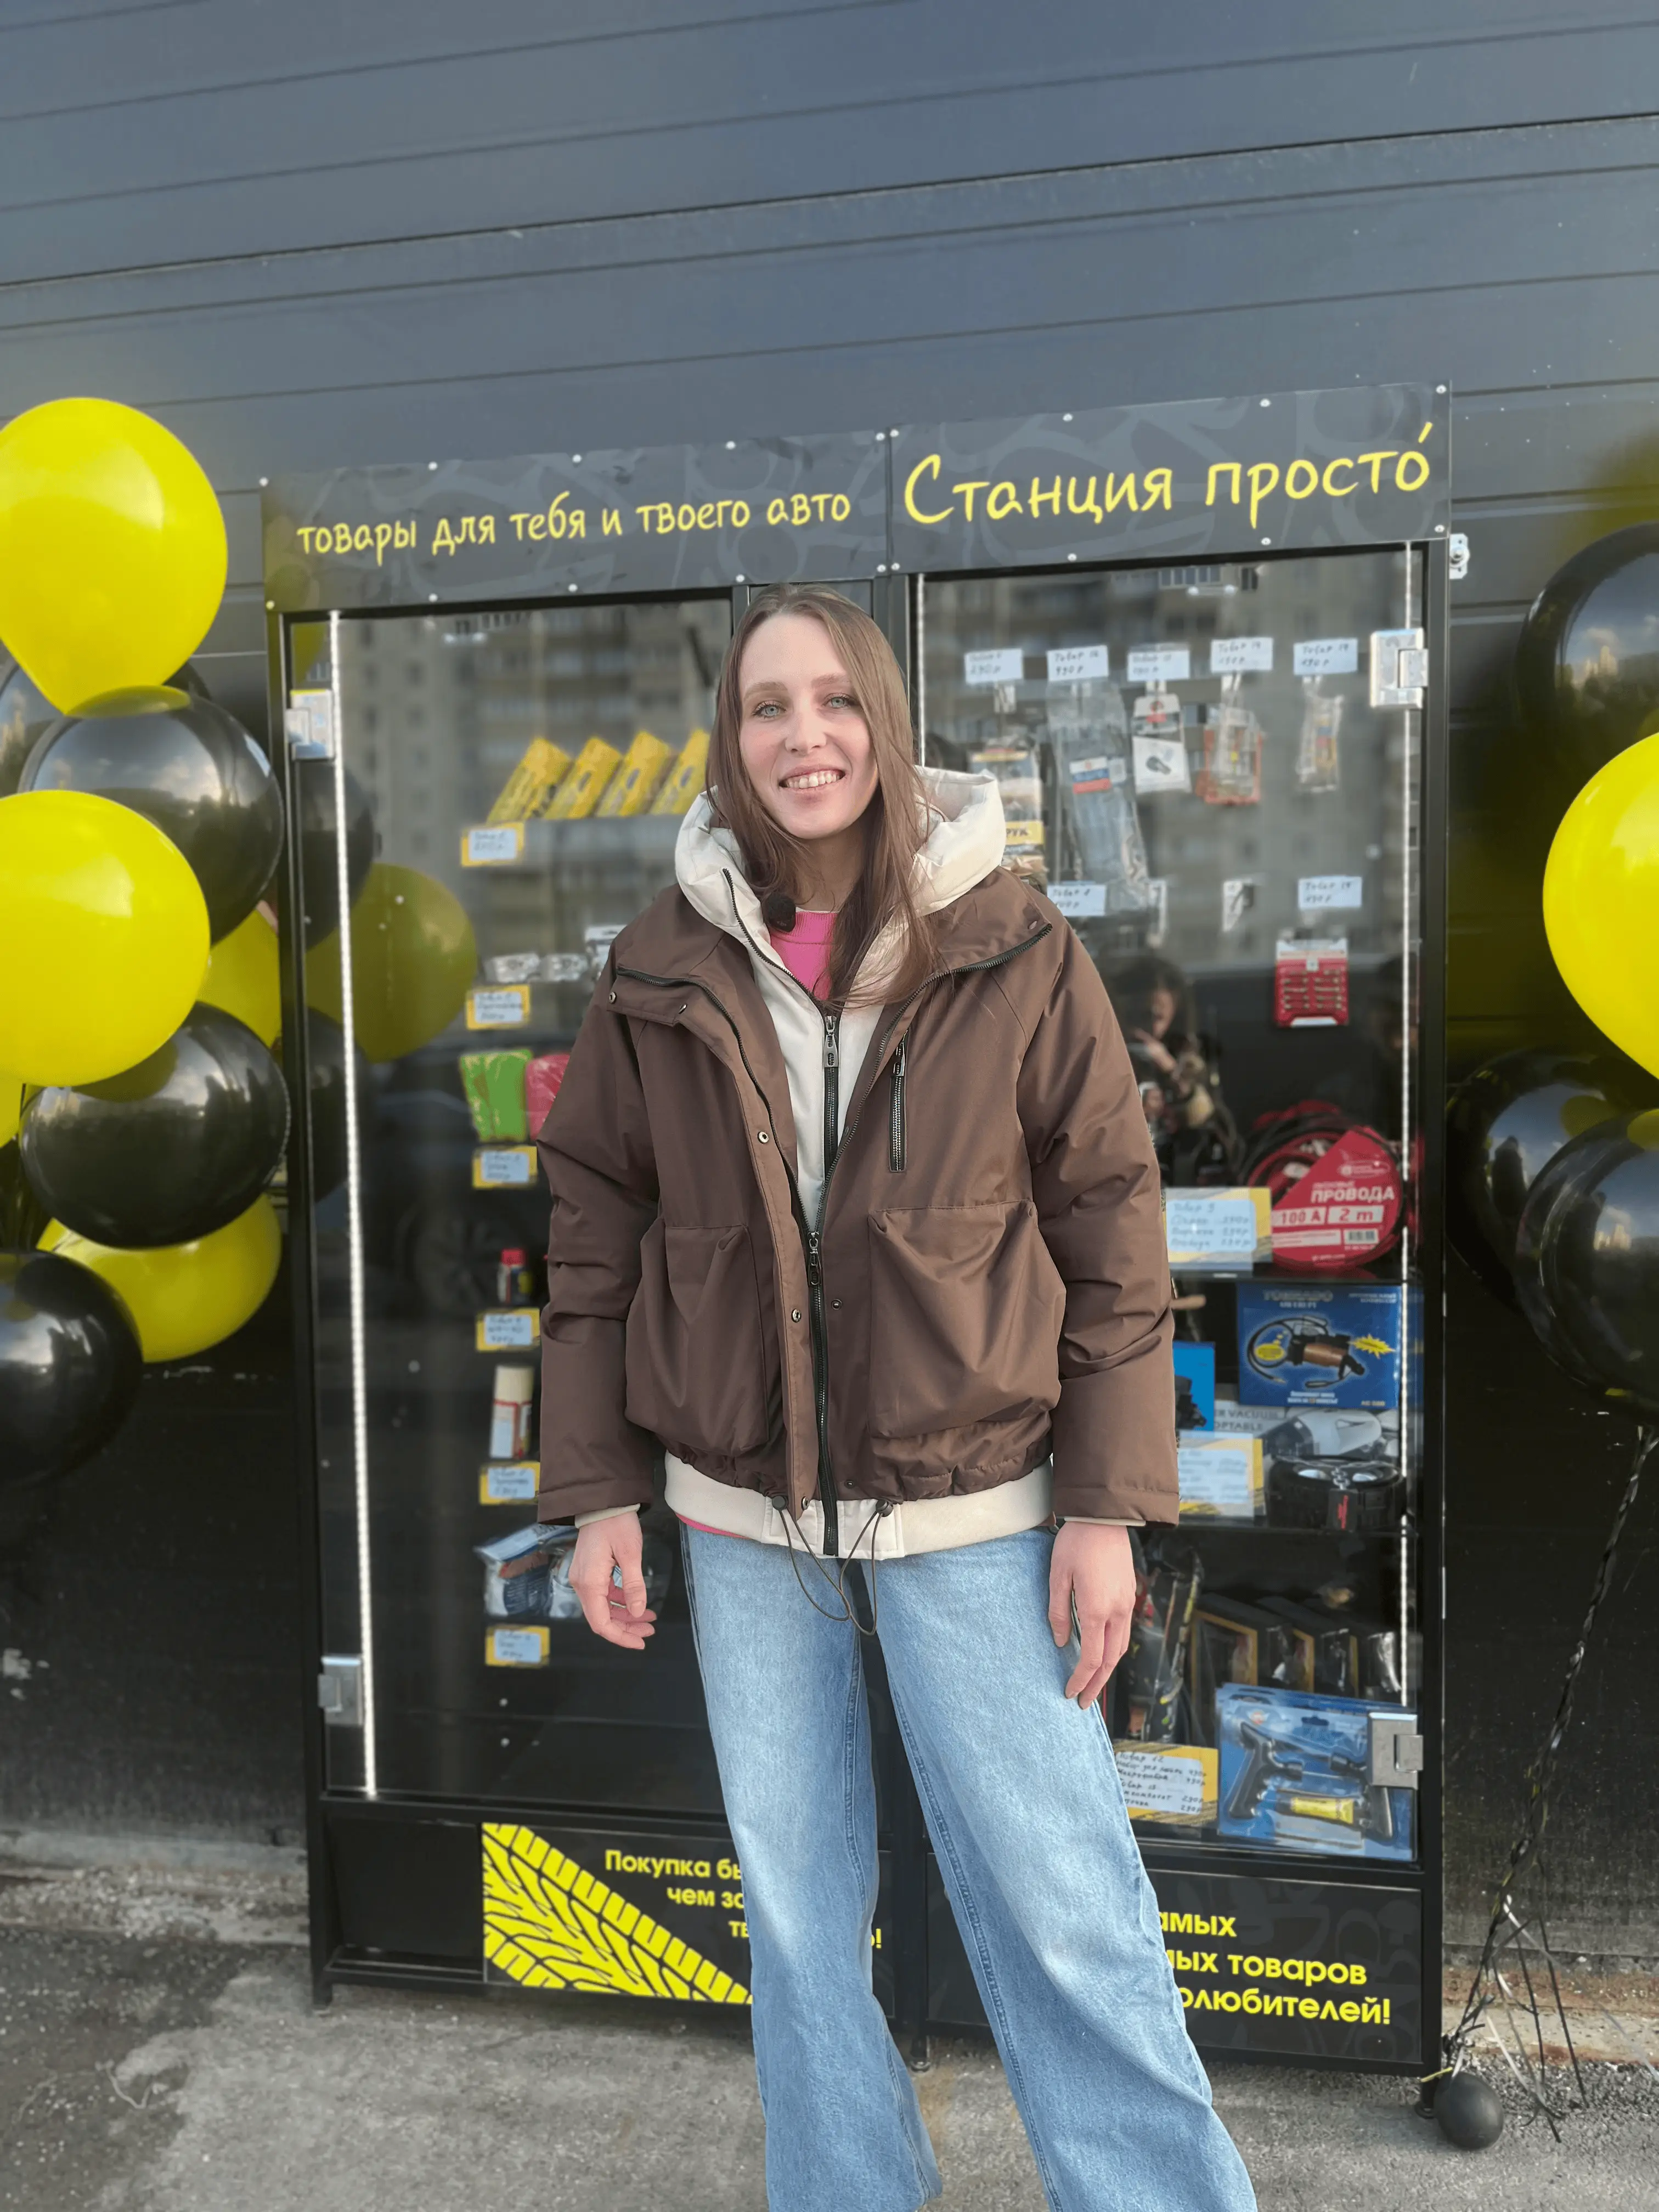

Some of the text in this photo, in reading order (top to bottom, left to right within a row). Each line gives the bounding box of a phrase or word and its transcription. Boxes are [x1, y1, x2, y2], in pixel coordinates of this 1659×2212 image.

[904, 454, 1172, 525] Станция
[296, 492, 851, 566] товары для тебя и твоего авто
[1311, 1186, 1396, 1204] ПРОВОДА
[1281, 1210, 1307, 1224] 100
[1333, 1207, 1350, 1222] 2
[605, 1849, 711, 1878] Покупка
[667, 1887, 715, 1907] чем
[1227, 1954, 1367, 1989] товаров
[1179, 1987, 1390, 2025] олюбителей!
